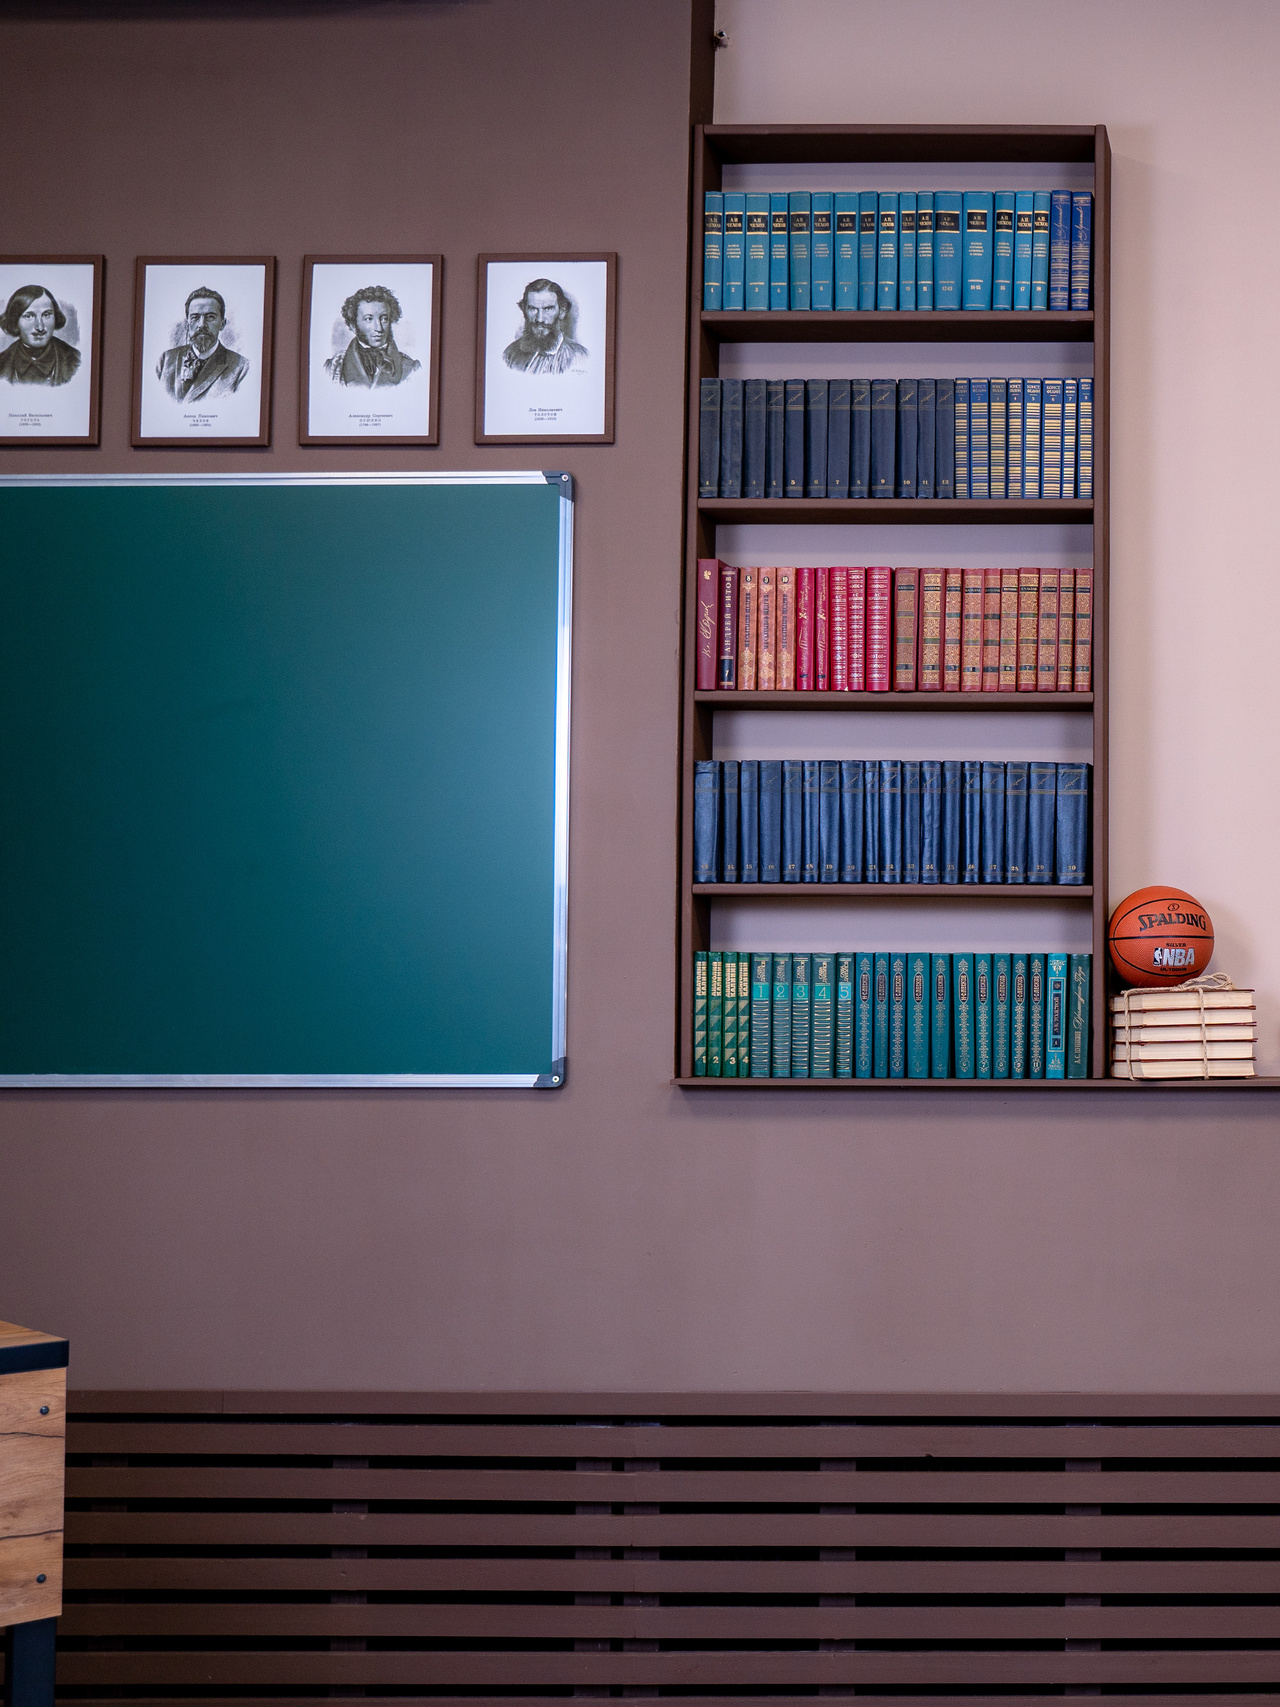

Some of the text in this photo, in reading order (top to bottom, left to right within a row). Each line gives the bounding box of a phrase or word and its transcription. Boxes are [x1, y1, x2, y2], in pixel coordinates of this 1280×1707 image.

[724, 613, 732, 653] АНДРЕЙ
[1138, 913, 1206, 932] SPALDING
[1162, 947, 1195, 966] NBA
[758, 986, 763, 997] 1
[776, 985, 786, 997] 2
[797, 985, 806, 997] 3
[818, 987, 826, 998] 4
[840, 986, 849, 998] 5
[713, 1056, 719, 1064] 2
